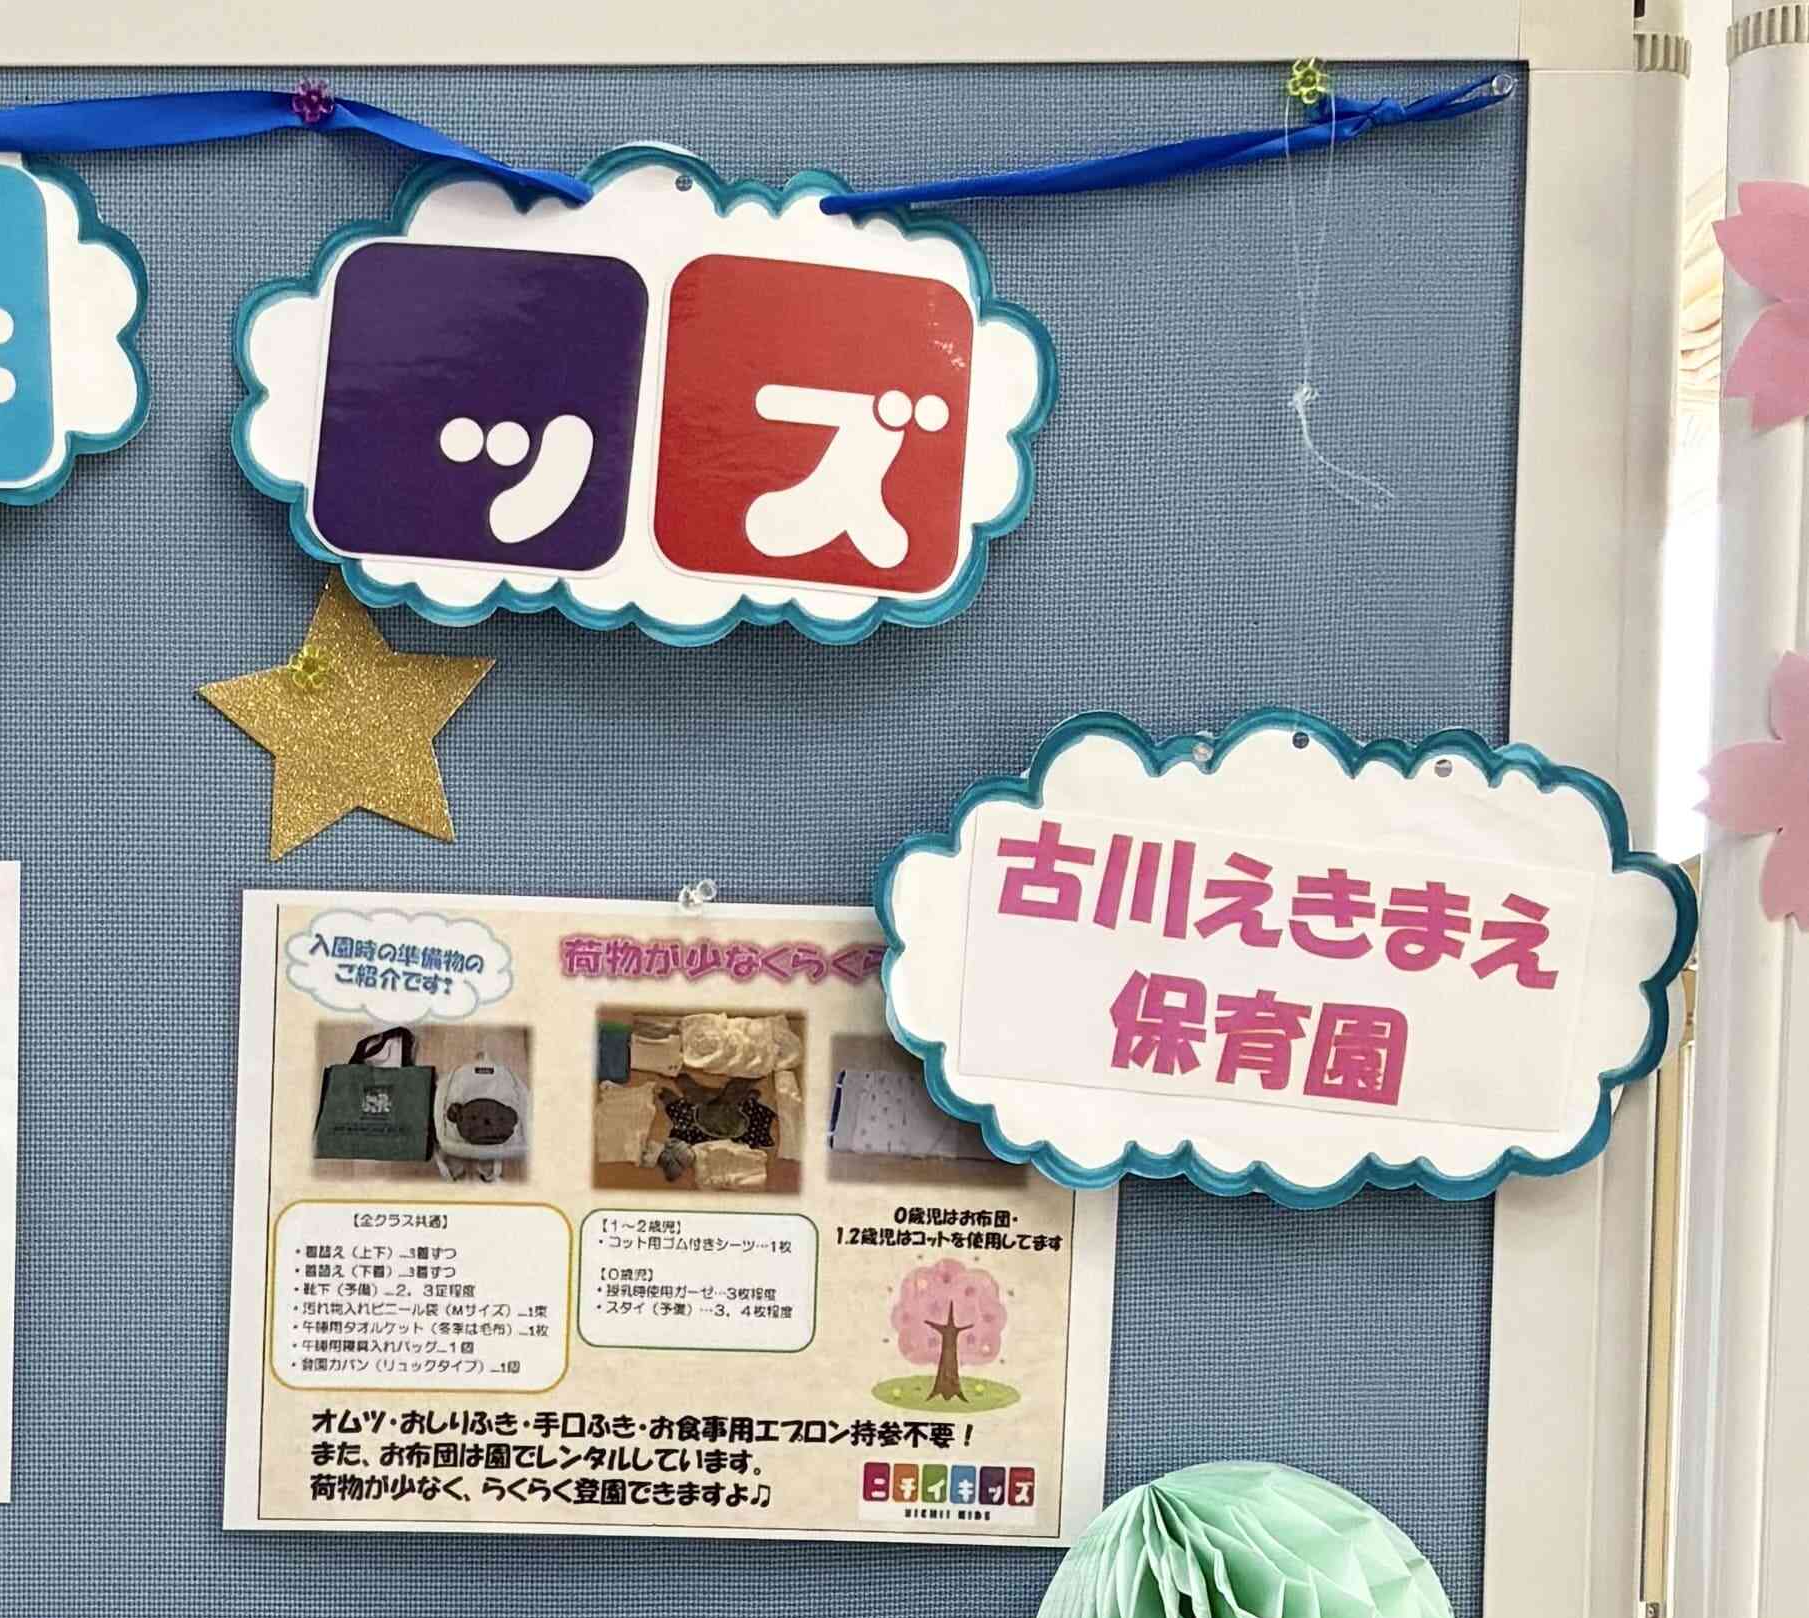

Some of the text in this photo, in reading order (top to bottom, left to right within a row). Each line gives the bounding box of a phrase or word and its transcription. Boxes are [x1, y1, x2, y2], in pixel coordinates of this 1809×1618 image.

[996, 819, 1560, 990] 古川えきまえ
[1108, 969, 1409, 1107] 保育園
[310, 1440, 762, 1476] また、お布団は園でレンタルしています。
[311, 1408, 974, 1449] オムツ・おしりふき・手口ふき・お食事用エプロン持参不要！
